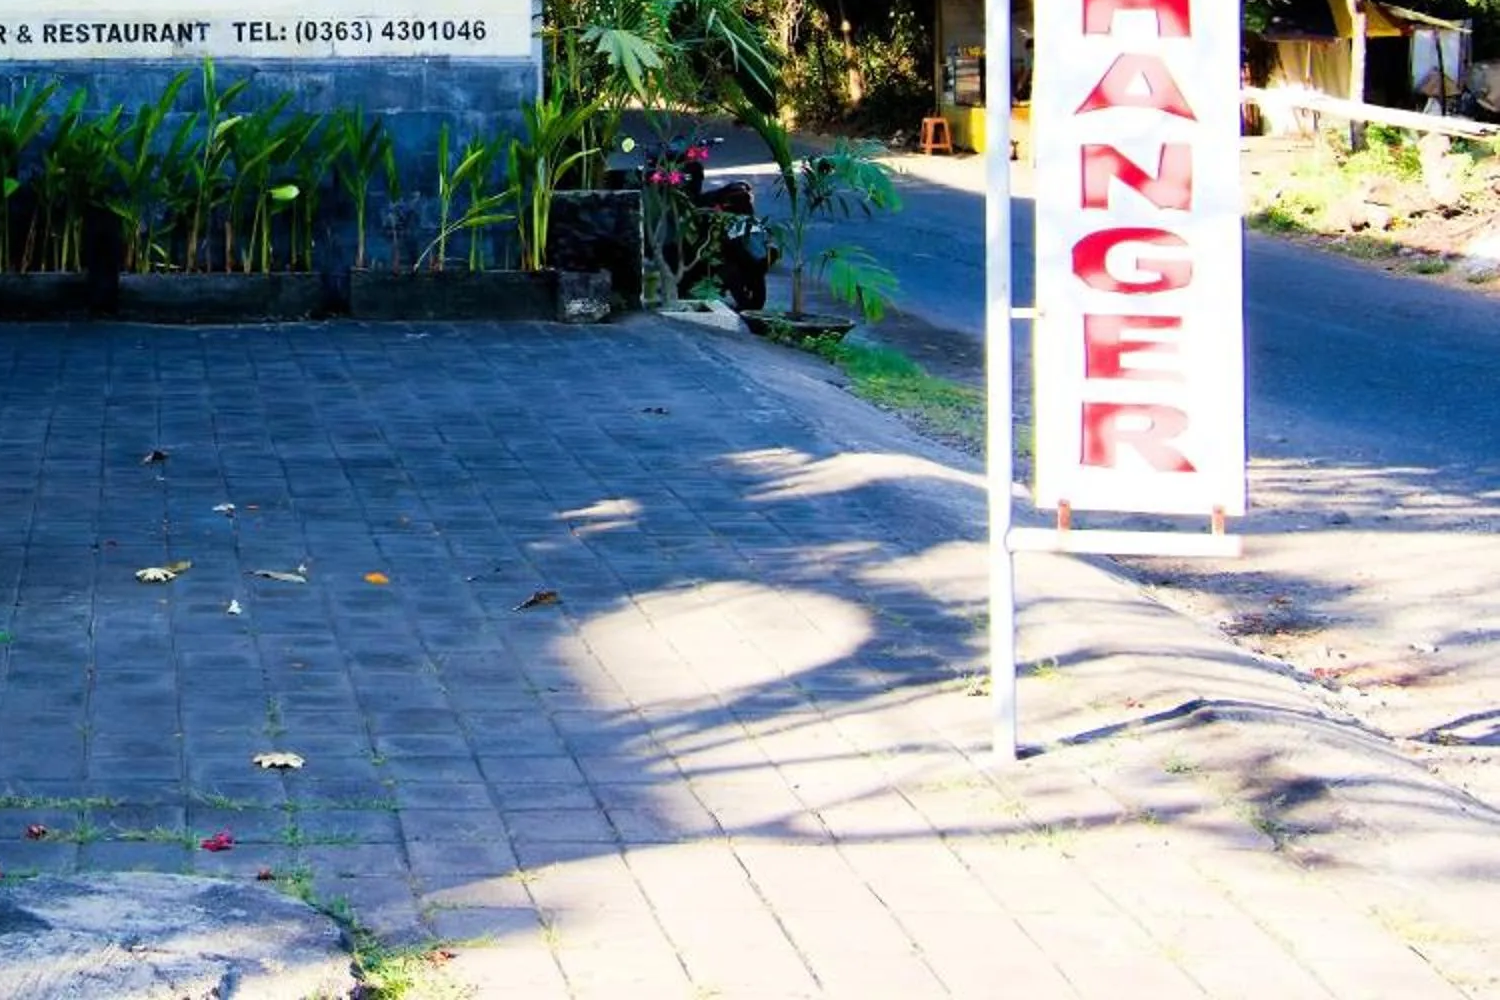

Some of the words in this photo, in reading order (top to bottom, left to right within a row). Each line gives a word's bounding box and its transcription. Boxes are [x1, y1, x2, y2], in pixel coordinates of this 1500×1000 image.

[16, 23, 33, 44] &
[43, 22, 211, 44] RESTAURANT
[233, 21, 287, 43] TEL:
[295, 20, 373, 43] (0363)
[381, 20, 487, 41] 4301046
